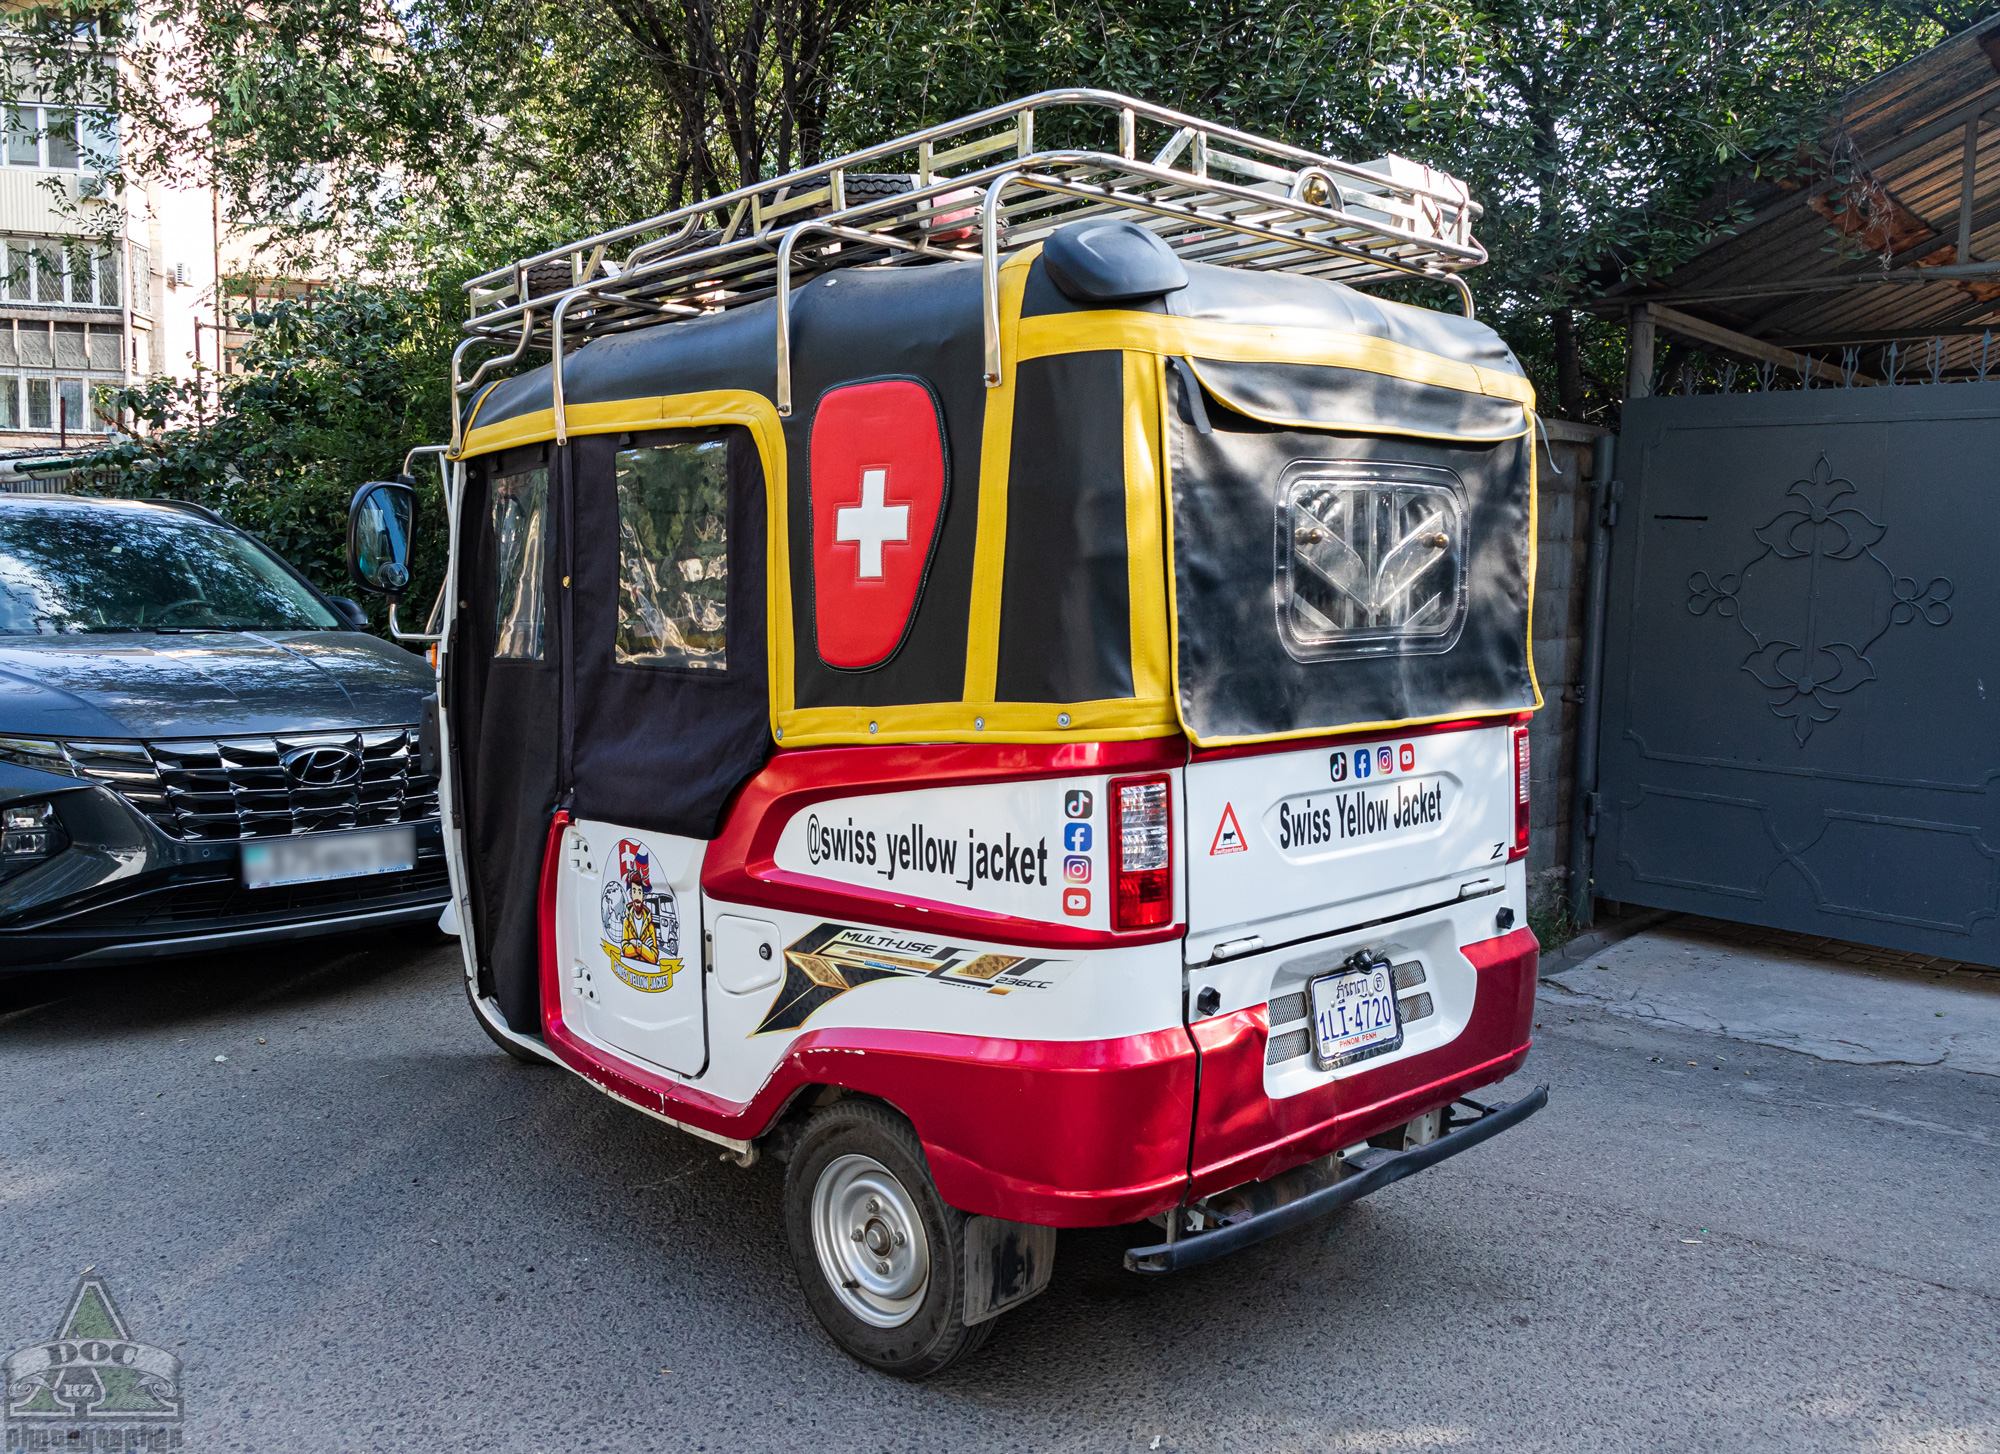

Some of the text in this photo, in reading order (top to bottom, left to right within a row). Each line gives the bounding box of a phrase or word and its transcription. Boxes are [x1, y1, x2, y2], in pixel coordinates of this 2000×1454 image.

[1280, 780, 1442, 849] Swiss Yellow Jacket
[807, 813, 1048, 891] @swiss_yellow_jacket
[840, 931, 938, 954] MULTI-USE
[613, 960, 669, 990] SWISS YELLOW JACKET
[995, 976, 1054, 989] 236CC
[1319, 995, 1392, 1041] 1LI-4720
[1339, 1031, 1377, 1048] PHNOM PENH
